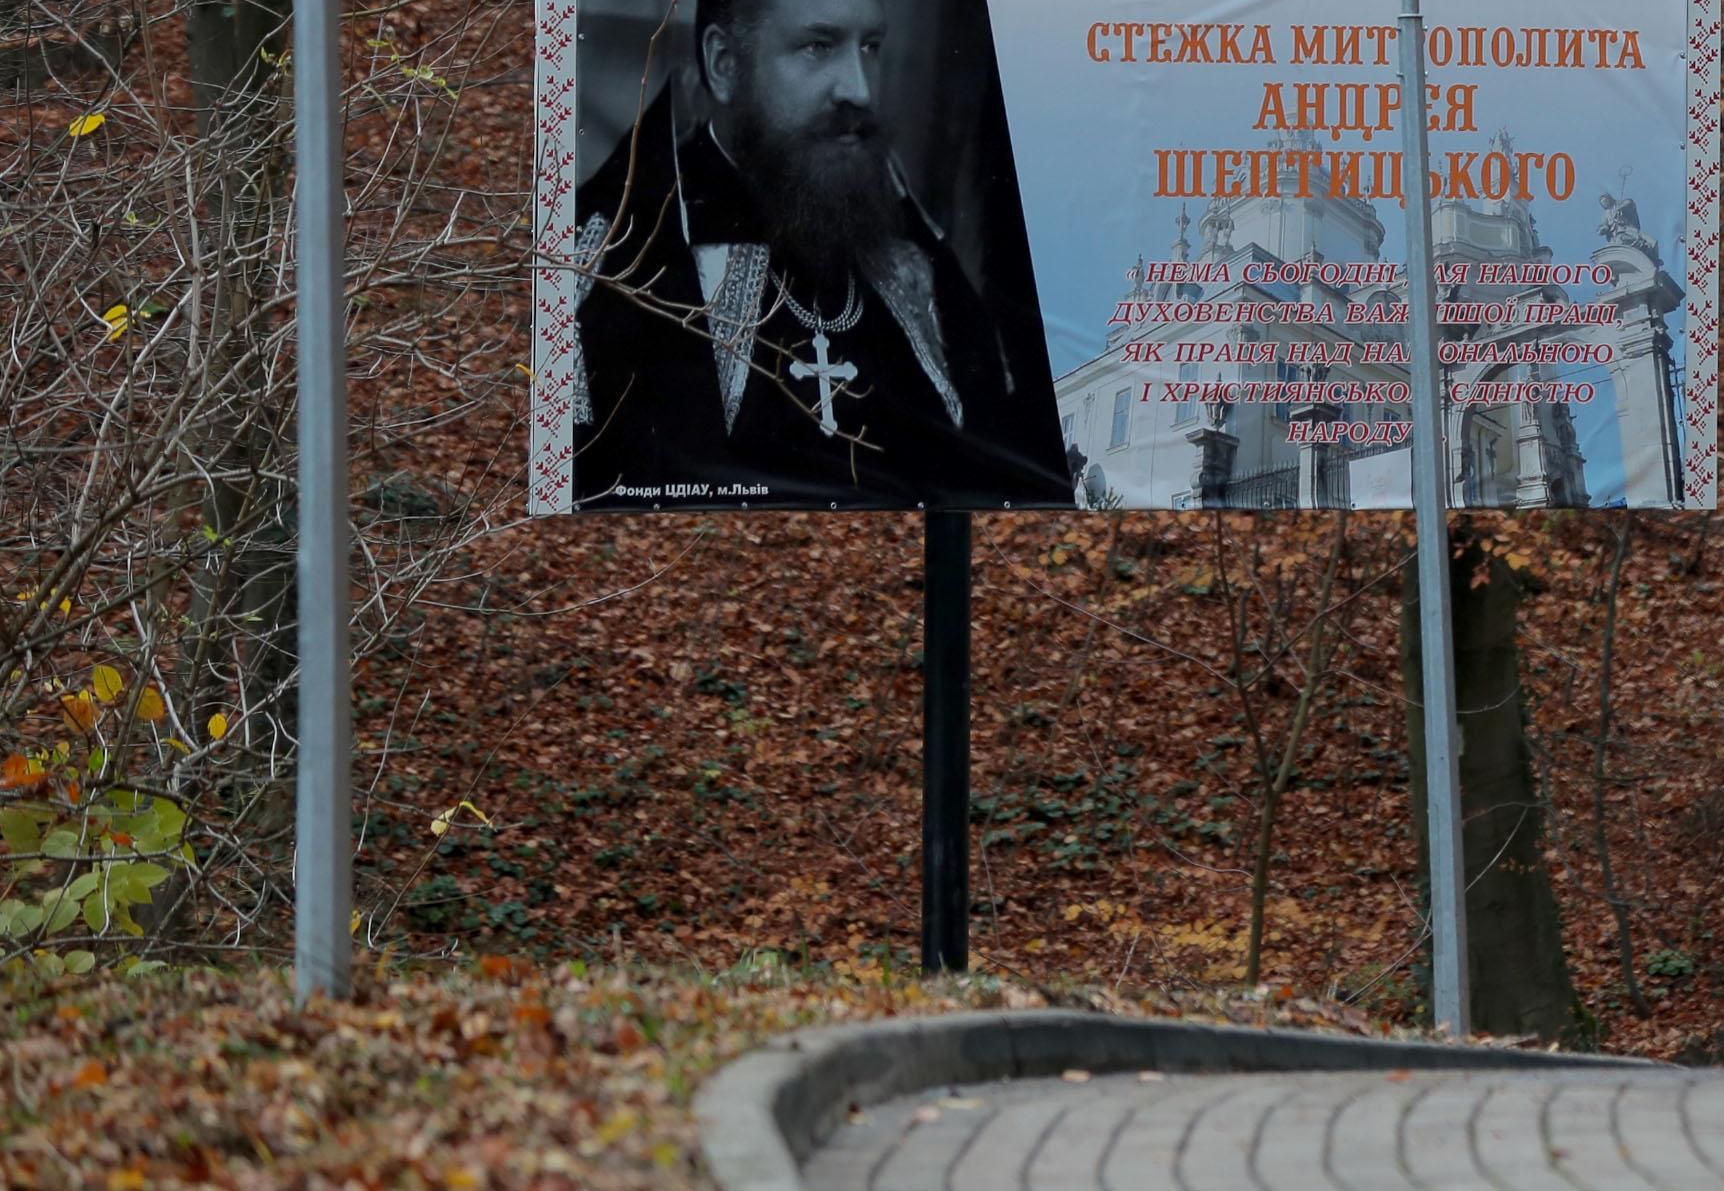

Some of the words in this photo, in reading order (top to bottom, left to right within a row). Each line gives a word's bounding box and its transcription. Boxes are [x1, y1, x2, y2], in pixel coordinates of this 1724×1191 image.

[1086, 22, 1275, 65] СТЕЖКА
[1290, 24, 1645, 70] МИТОПОЛИТА
[1146, 262, 1231, 283] НЕМА
[1242, 262, 1398, 287] СЬОГОДНІ
[1403, 262, 1470, 286] ЛЯ
[1480, 264, 1611, 284] НАШОГО
[1108, 301, 1335, 326] ДУХОВЕНСТВА
[1121, 342, 1165, 363] ЯК
[1174, 342, 1278, 366] ПРАЦЯ
[1287, 342, 1354, 366] НАД
[1361, 342, 1615, 364] НАОНАЛЬНОЮ
[1140, 383, 1152, 403] І
[1163, 382, 1411, 404] ХРИСТИЯНСЬКО
[1450, 382, 1595, 406] ЄДНІСТЮ
[613, 483, 662, 498] Фонди
[665, 483, 713, 498] ЦДІАУ,
